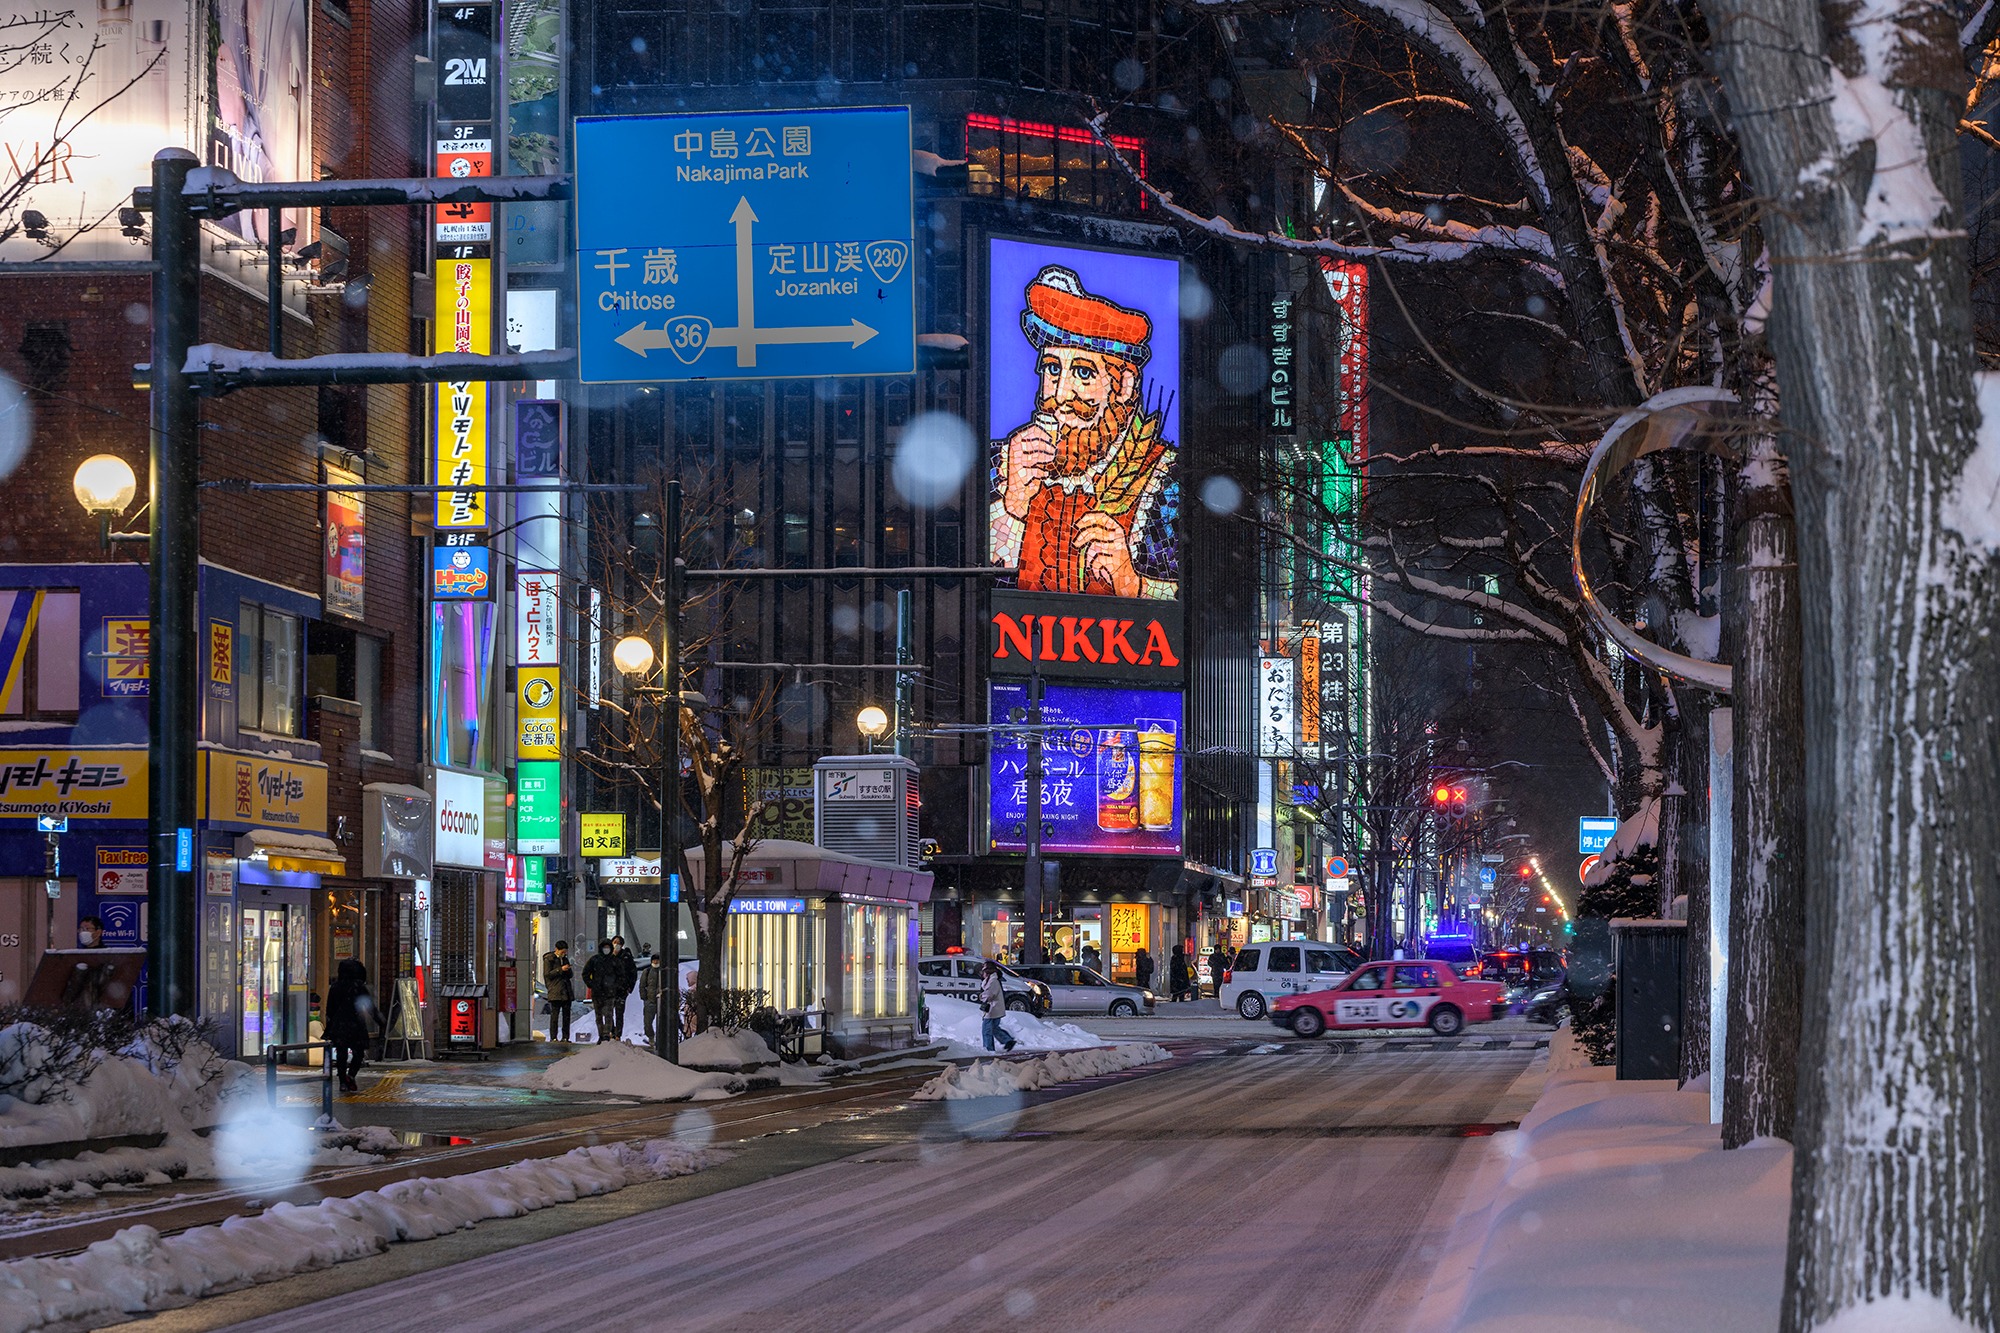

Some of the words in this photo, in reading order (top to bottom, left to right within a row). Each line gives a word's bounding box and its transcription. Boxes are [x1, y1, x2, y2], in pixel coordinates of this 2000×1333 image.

[455, 8, 475, 20] 4F
[444, 58, 486, 85] 2M
[454, 127, 474, 139] 3F
[674, 126, 812, 160] 中島公園
[676, 164, 764, 185] Nakajima
[767, 162, 809, 181] Park
[454, 246, 473, 258] 1F
[769, 242, 864, 275] 定山渓
[873, 248, 902, 269] 230
[594, 248, 679, 287] 千歳
[775, 279, 858, 298] Jozankei
[455, 264, 472, 353] 餃子の山岡家
[598, 291, 675, 312] Chitose
[674, 324, 703, 348] 36
[520, 450, 557, 473] ビル
[447, 534, 476, 546] B1F
[526, 581, 541, 661] ほっとハウス
[991, 611, 1181, 668] NIKKA
[213, 627, 229, 681] 薬
[110, 680, 150, 694] マツモト
[525, 723, 553, 732] CoCo
[521, 733, 556, 746] 壱番屋
[238, 768, 250, 812] 薬
[859, 785, 892, 793] すすきの駅
[58, 801, 111, 814] KiYoshi
[441, 799, 479, 836] docomo
[583, 836, 621, 848] 四文屋
[99, 850, 121, 864] Tax
[121, 850, 148, 864] Free
[740, 901, 762, 911] POLE
[765, 901, 787, 911] TOWN
[1112, 909, 1121, 948] スクエア
[937, 993, 980, 1002] POLIC
[1388, 1001, 1421, 1019] GO
